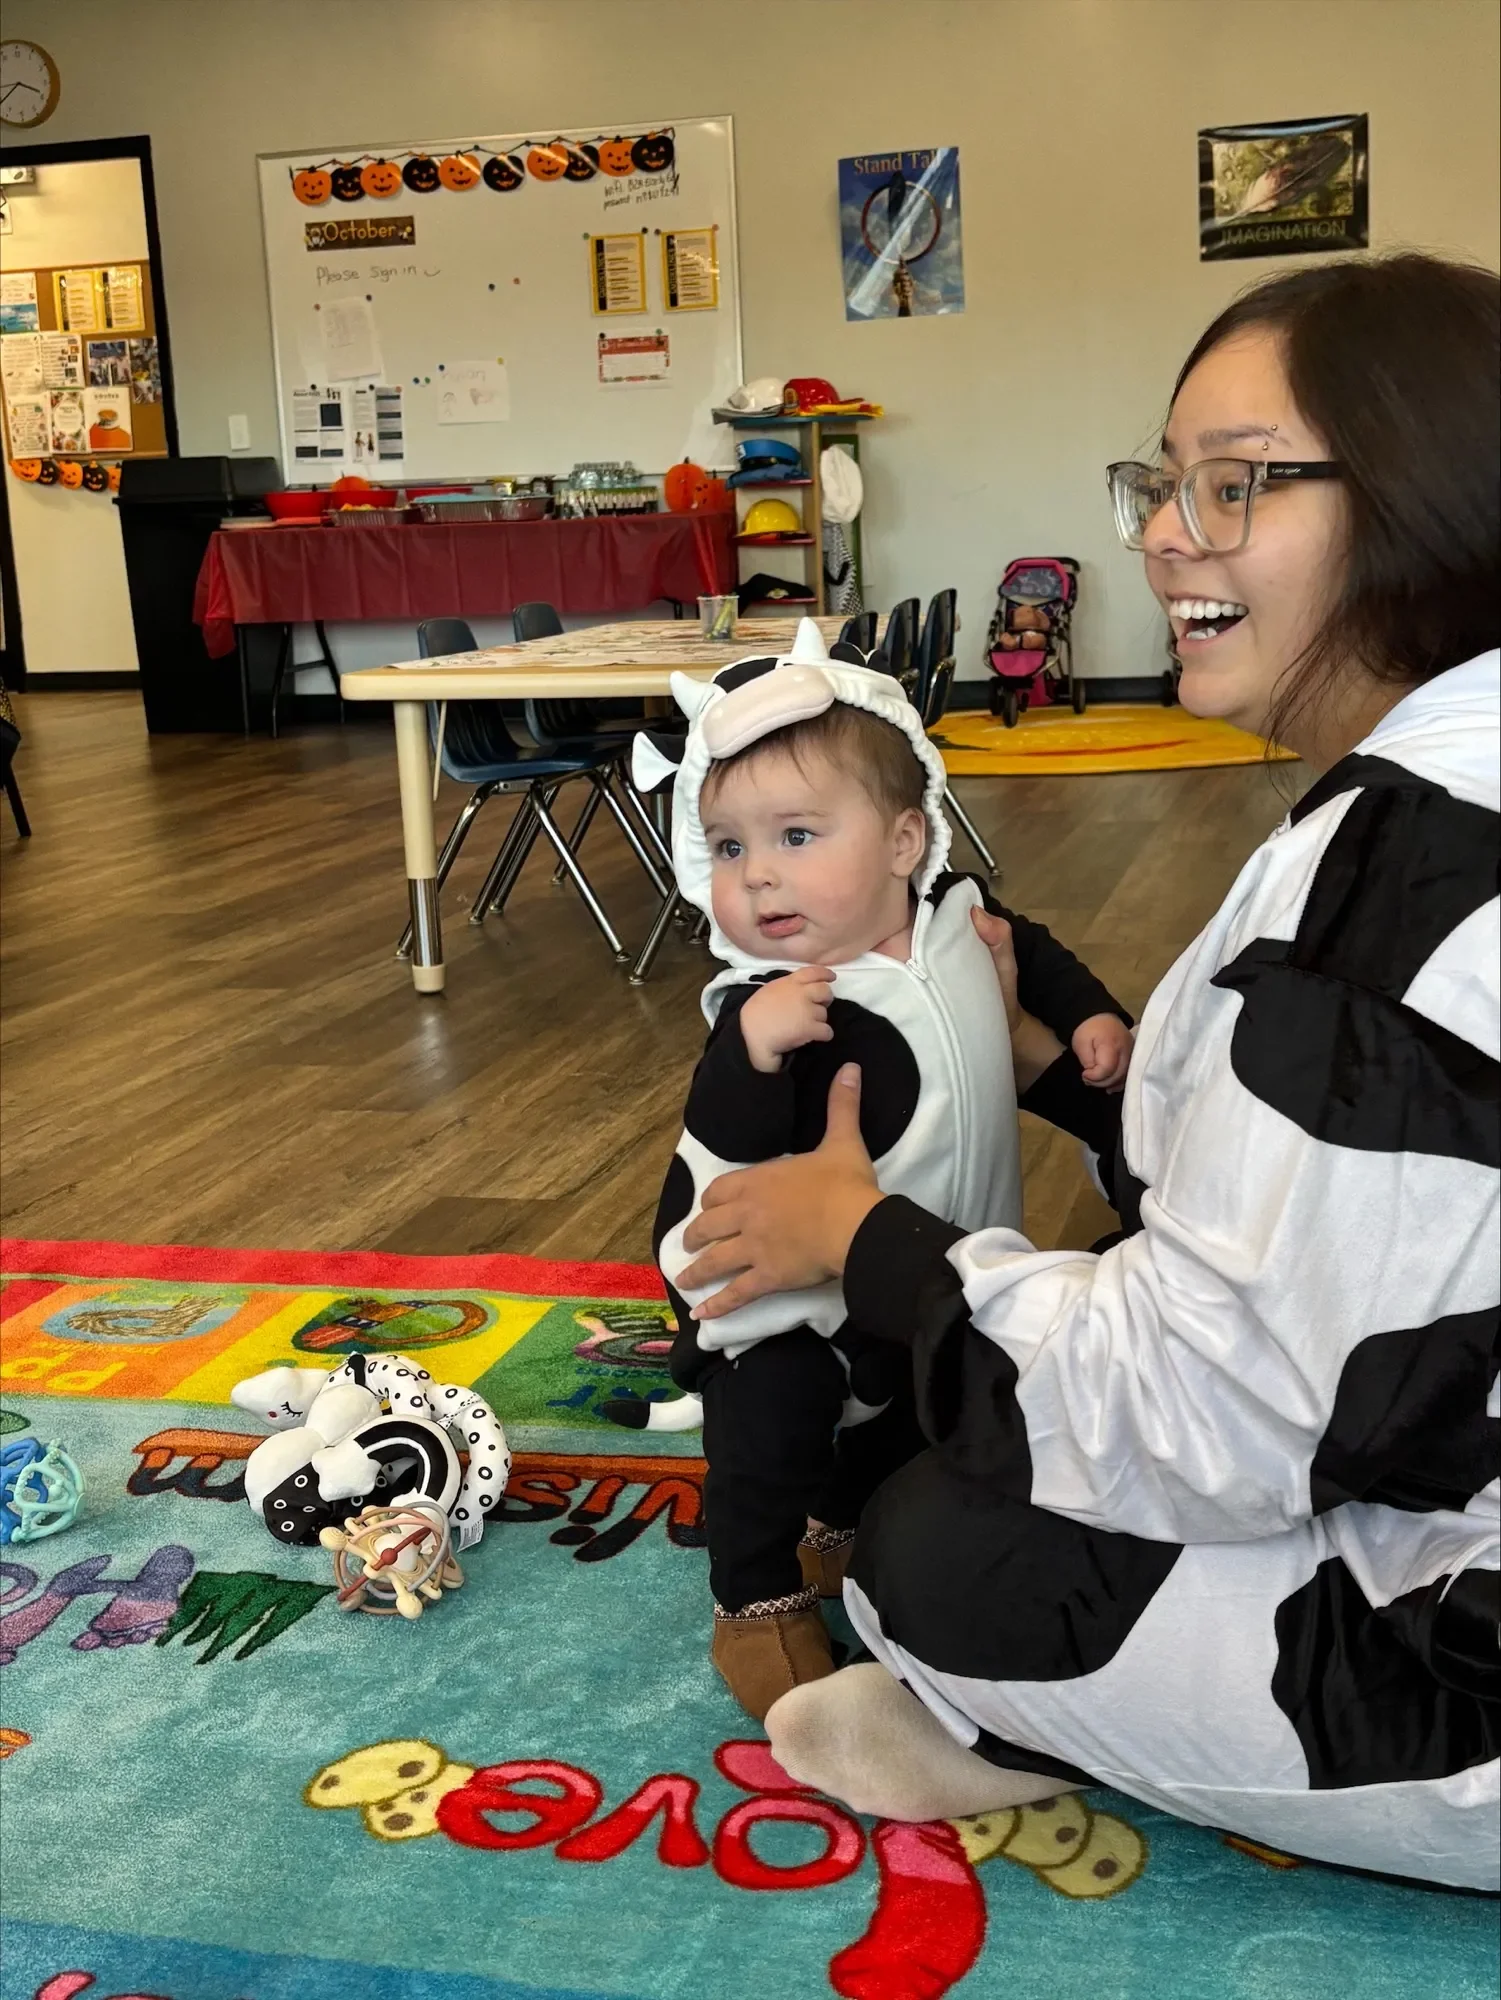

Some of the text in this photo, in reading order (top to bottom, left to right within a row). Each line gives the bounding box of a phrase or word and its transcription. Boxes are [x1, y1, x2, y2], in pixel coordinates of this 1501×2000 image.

[853, 152, 903, 174] Stand
[323, 219, 397, 242] October
[1221, 219, 1347, 245] IMAGINATION
[316, 265, 360, 287] Please
